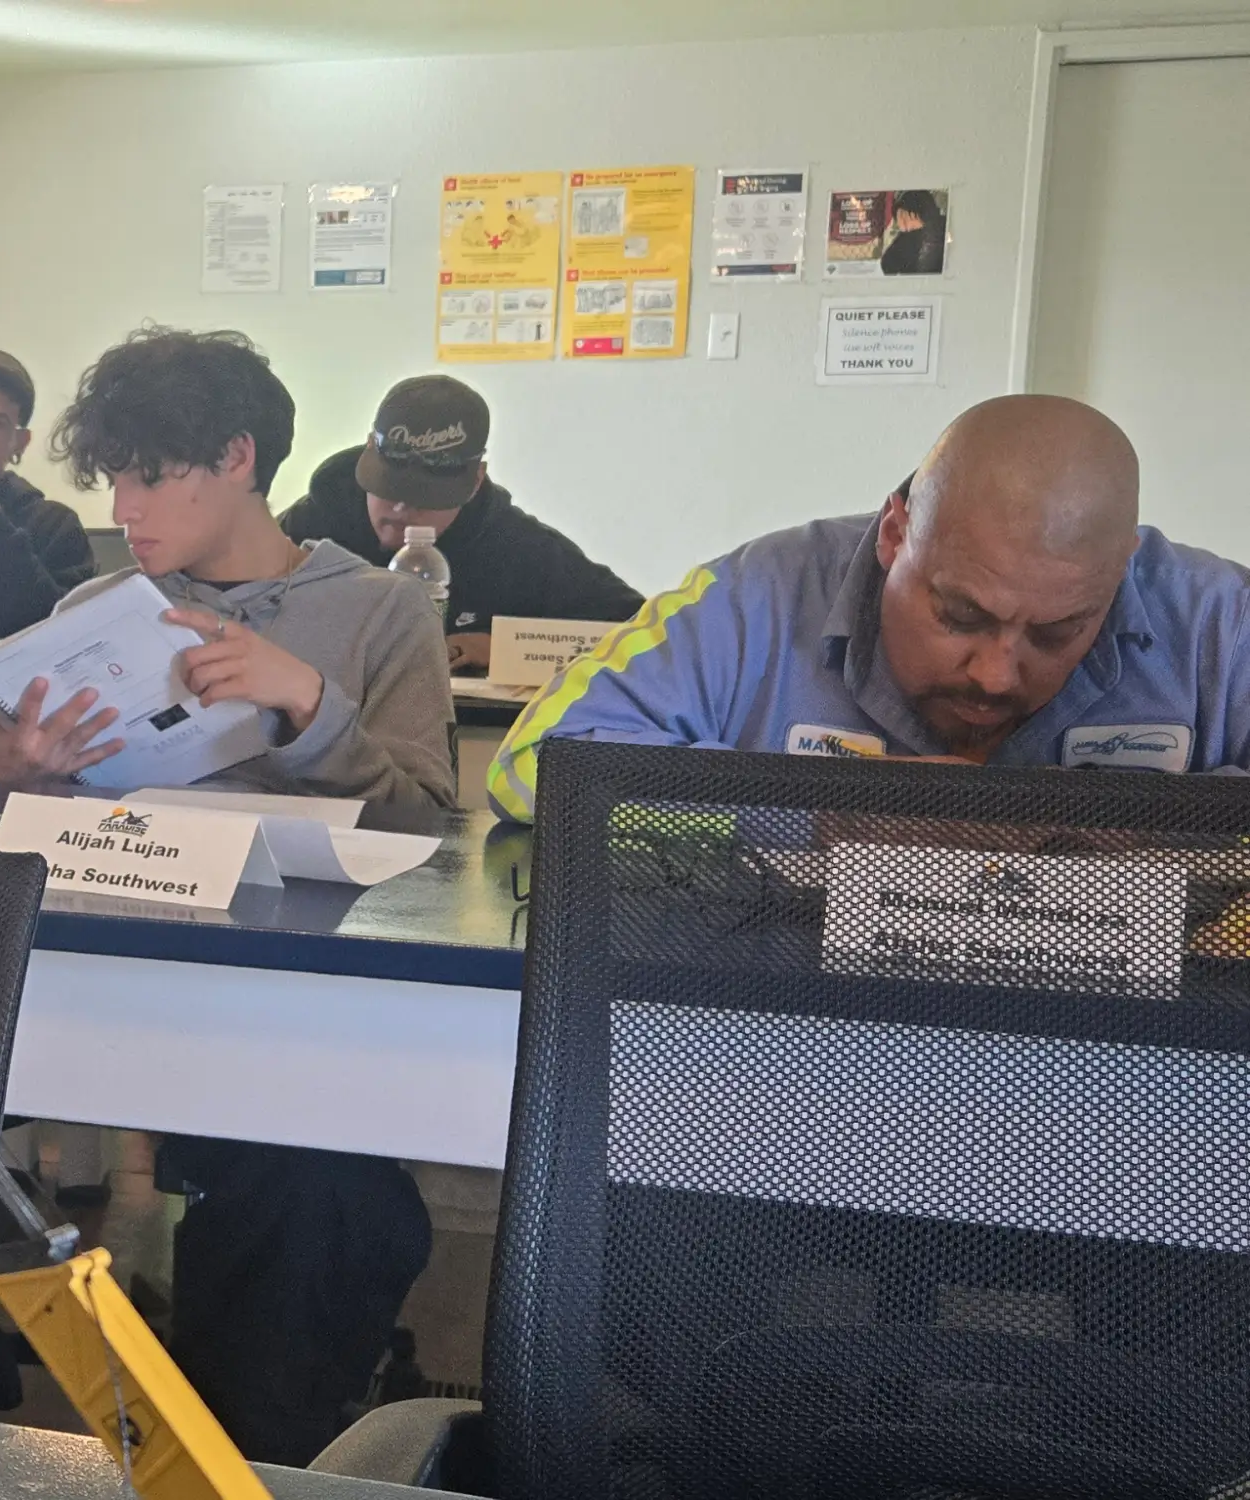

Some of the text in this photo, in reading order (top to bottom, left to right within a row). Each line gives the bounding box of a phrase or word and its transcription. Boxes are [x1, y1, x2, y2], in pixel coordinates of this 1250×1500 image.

[835, 310, 926, 321] QUIET PLEASE
[840, 358, 914, 368] THANK YOU
[387, 420, 467, 452] Dodgers
[514, 631, 586, 645] Southwest
[56, 829, 180, 858] Alijah Lujan
[81, 867, 199, 897] Southwest
